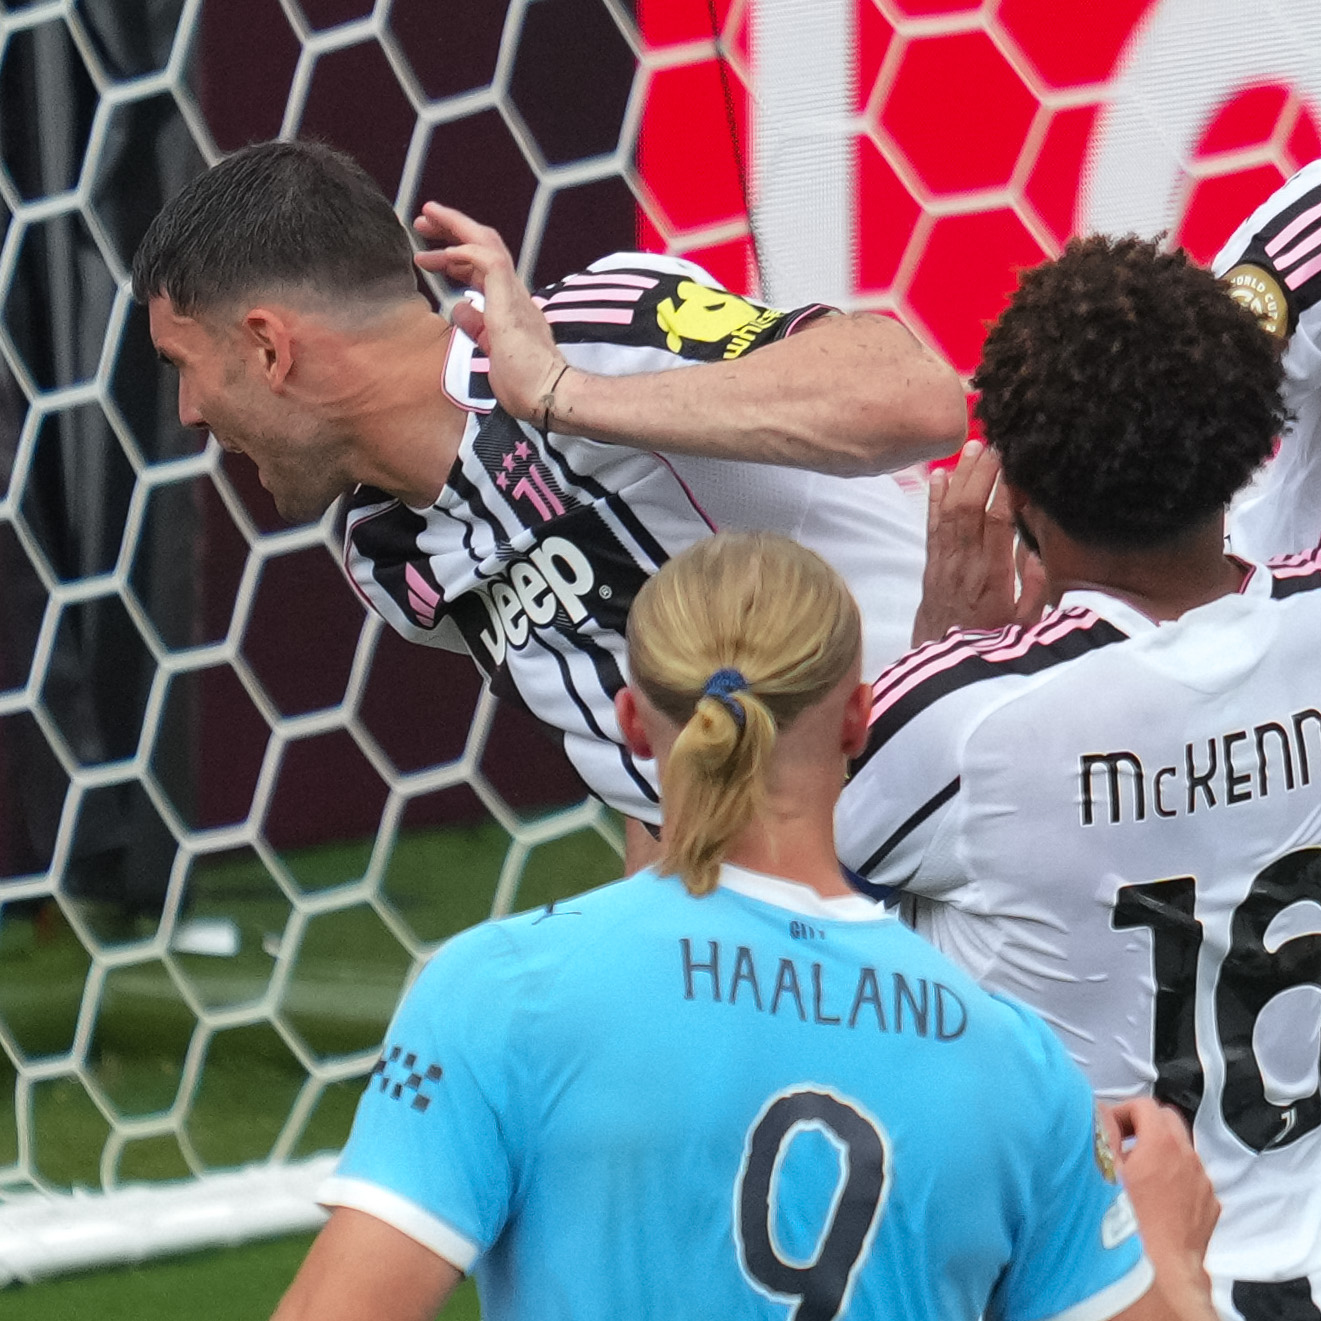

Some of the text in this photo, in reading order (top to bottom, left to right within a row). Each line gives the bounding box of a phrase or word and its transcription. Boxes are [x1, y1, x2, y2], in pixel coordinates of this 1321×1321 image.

[479, 536, 595, 666] Jeep
[679, 936, 969, 1042] HAALAND
[734, 1084, 891, 1321] 9
